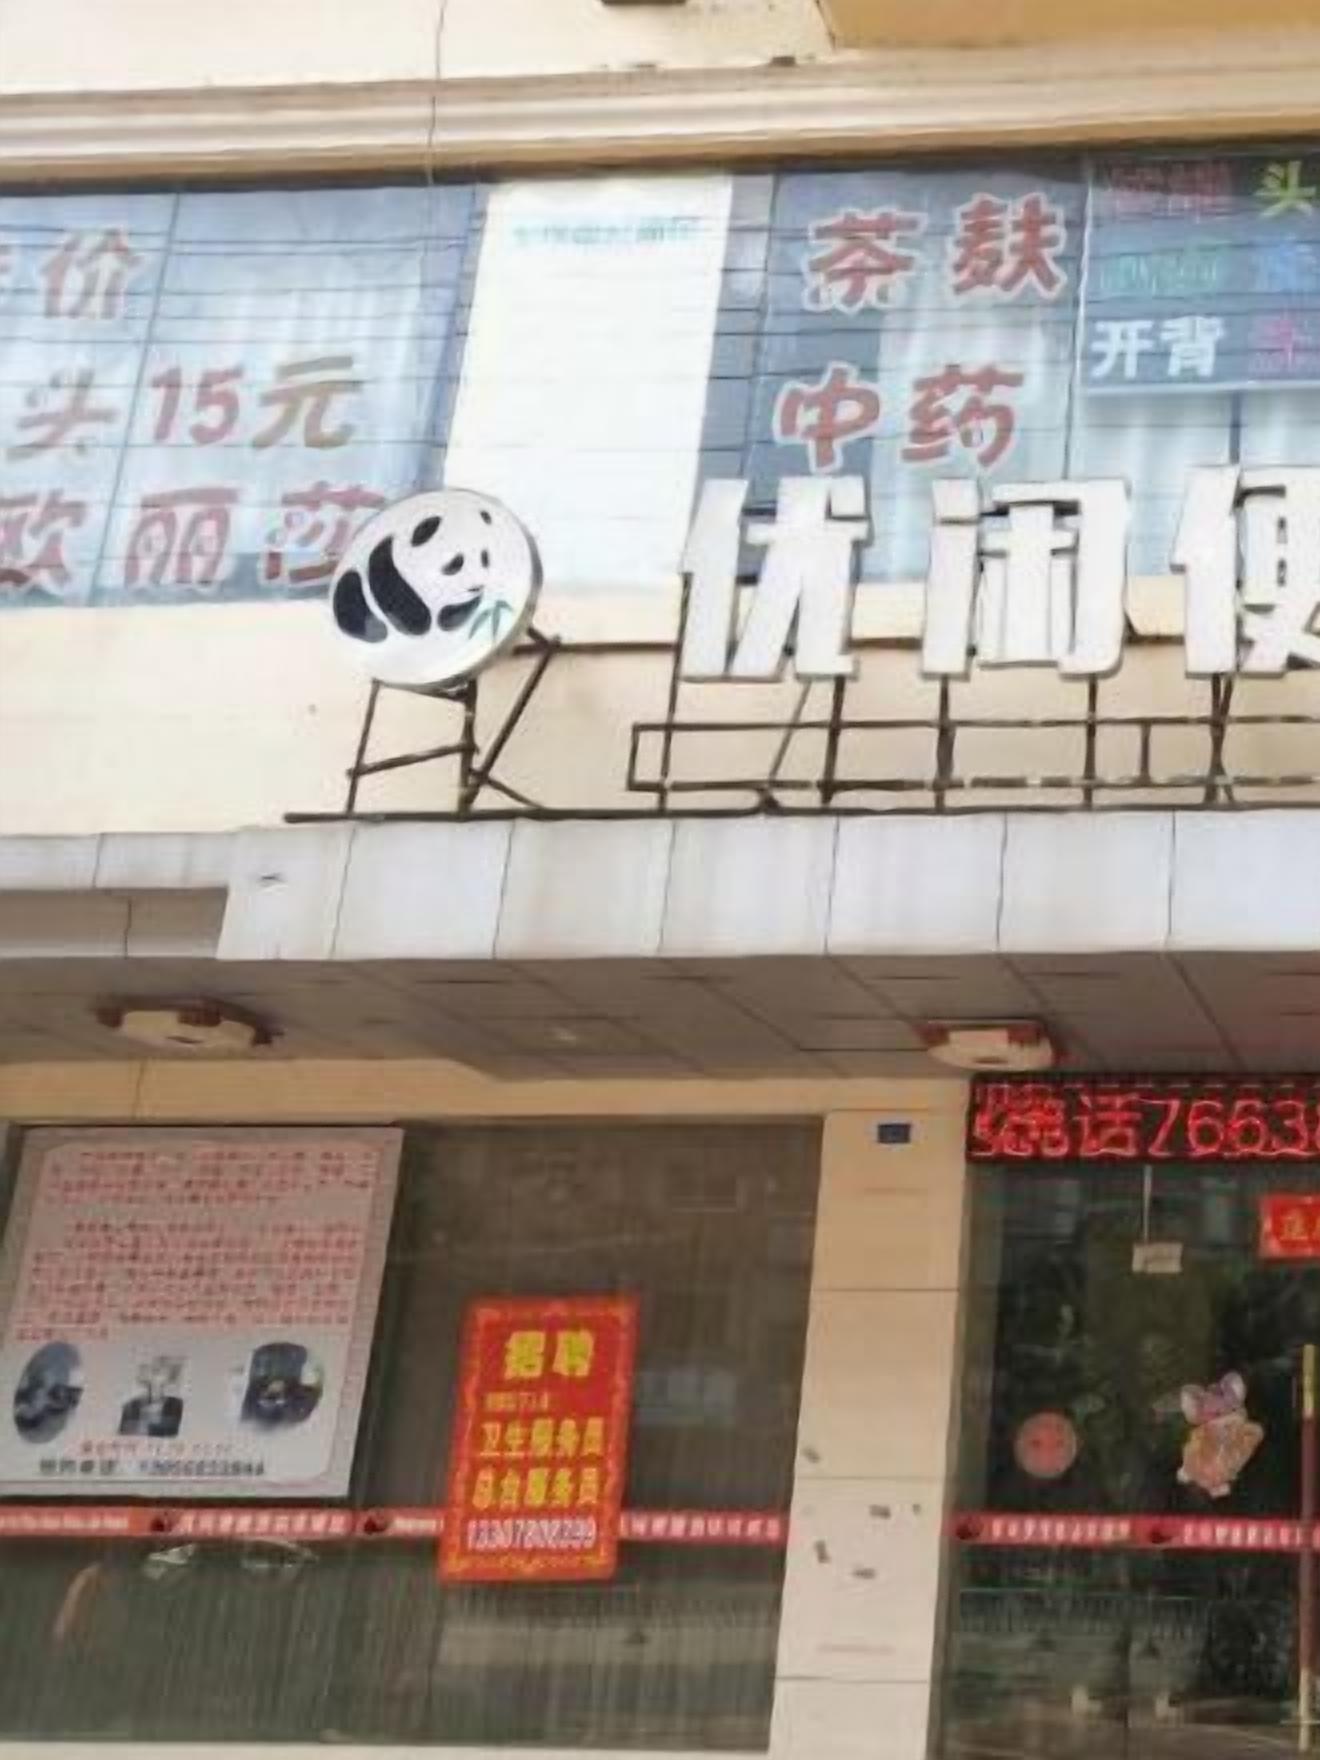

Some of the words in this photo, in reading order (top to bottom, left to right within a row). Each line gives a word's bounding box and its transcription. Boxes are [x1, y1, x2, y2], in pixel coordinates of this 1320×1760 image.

[0, 228, 142, 320] 价
[1091, 315, 1226, 381] 开背
[777, 363, 1025, 471] 中药
